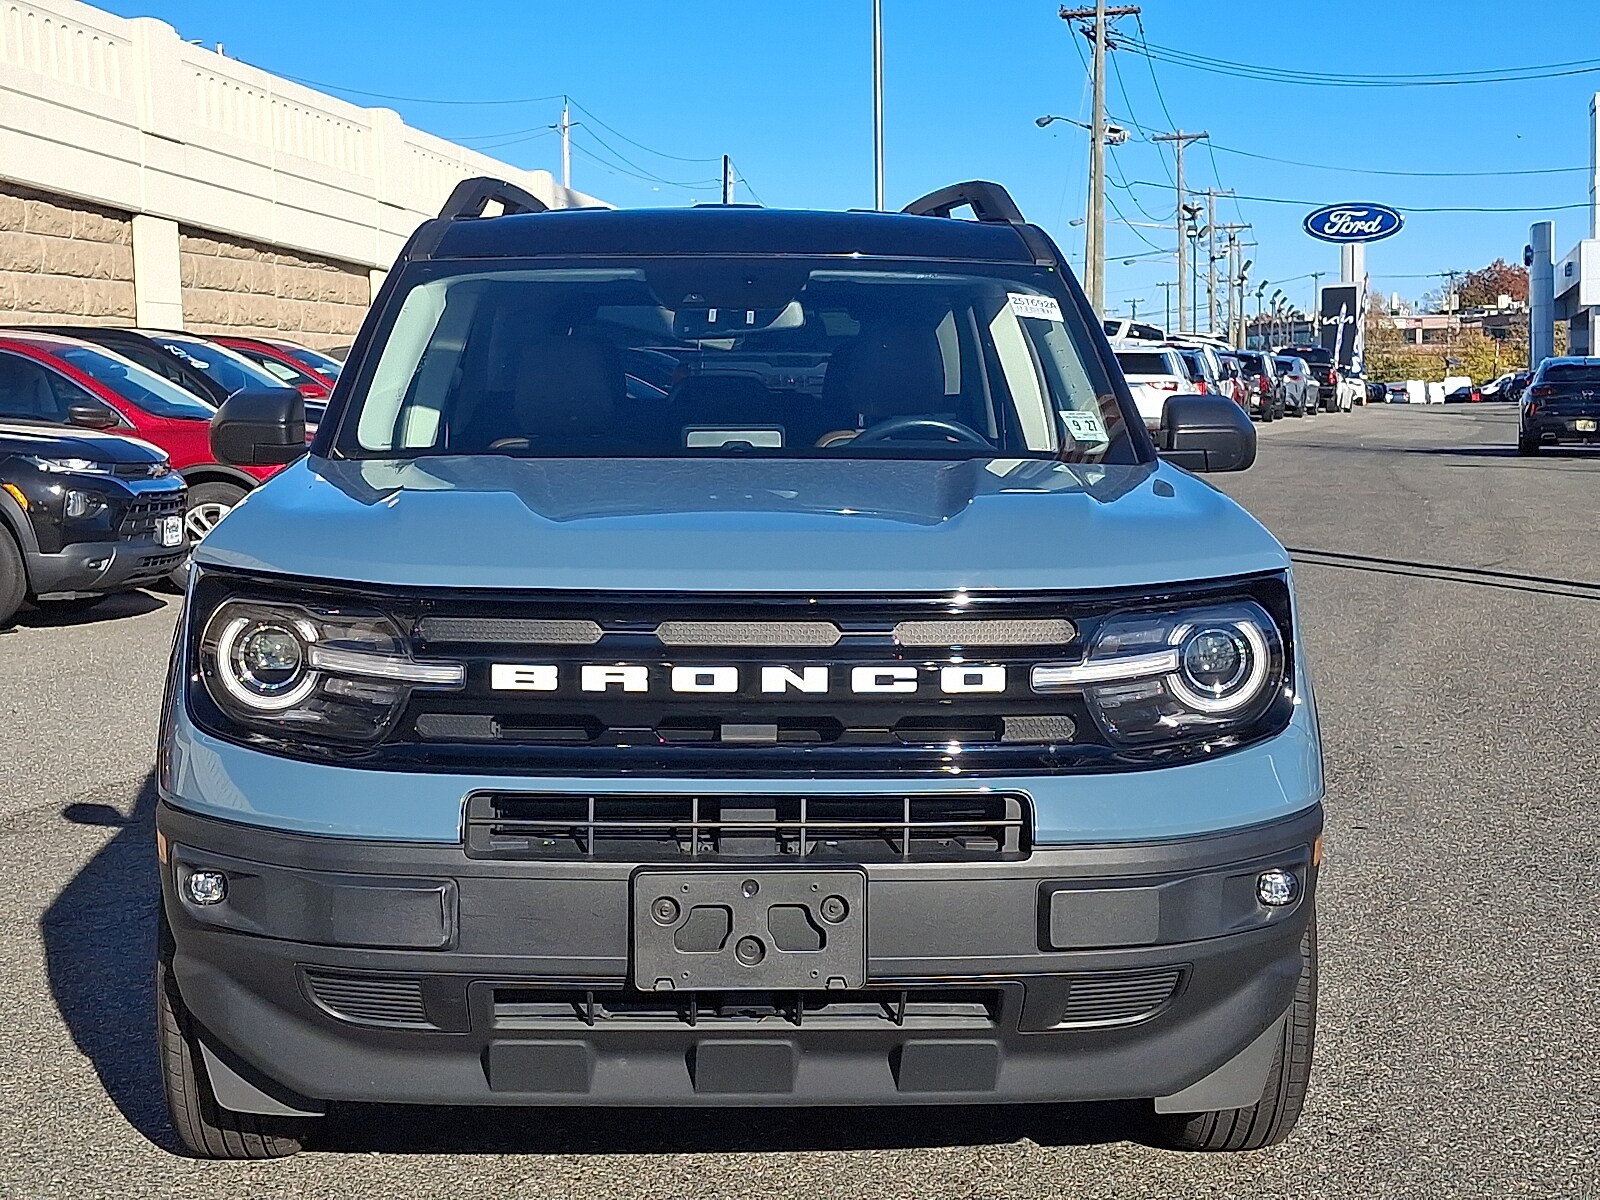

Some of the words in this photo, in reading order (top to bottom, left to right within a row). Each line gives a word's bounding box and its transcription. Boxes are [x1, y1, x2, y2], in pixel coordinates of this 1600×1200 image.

[1323, 210, 1383, 234] Ford
[1072, 419, 1081, 431] 9
[1084, 420, 1098, 431] 27
[491, 664, 1006, 693] BRONCO
